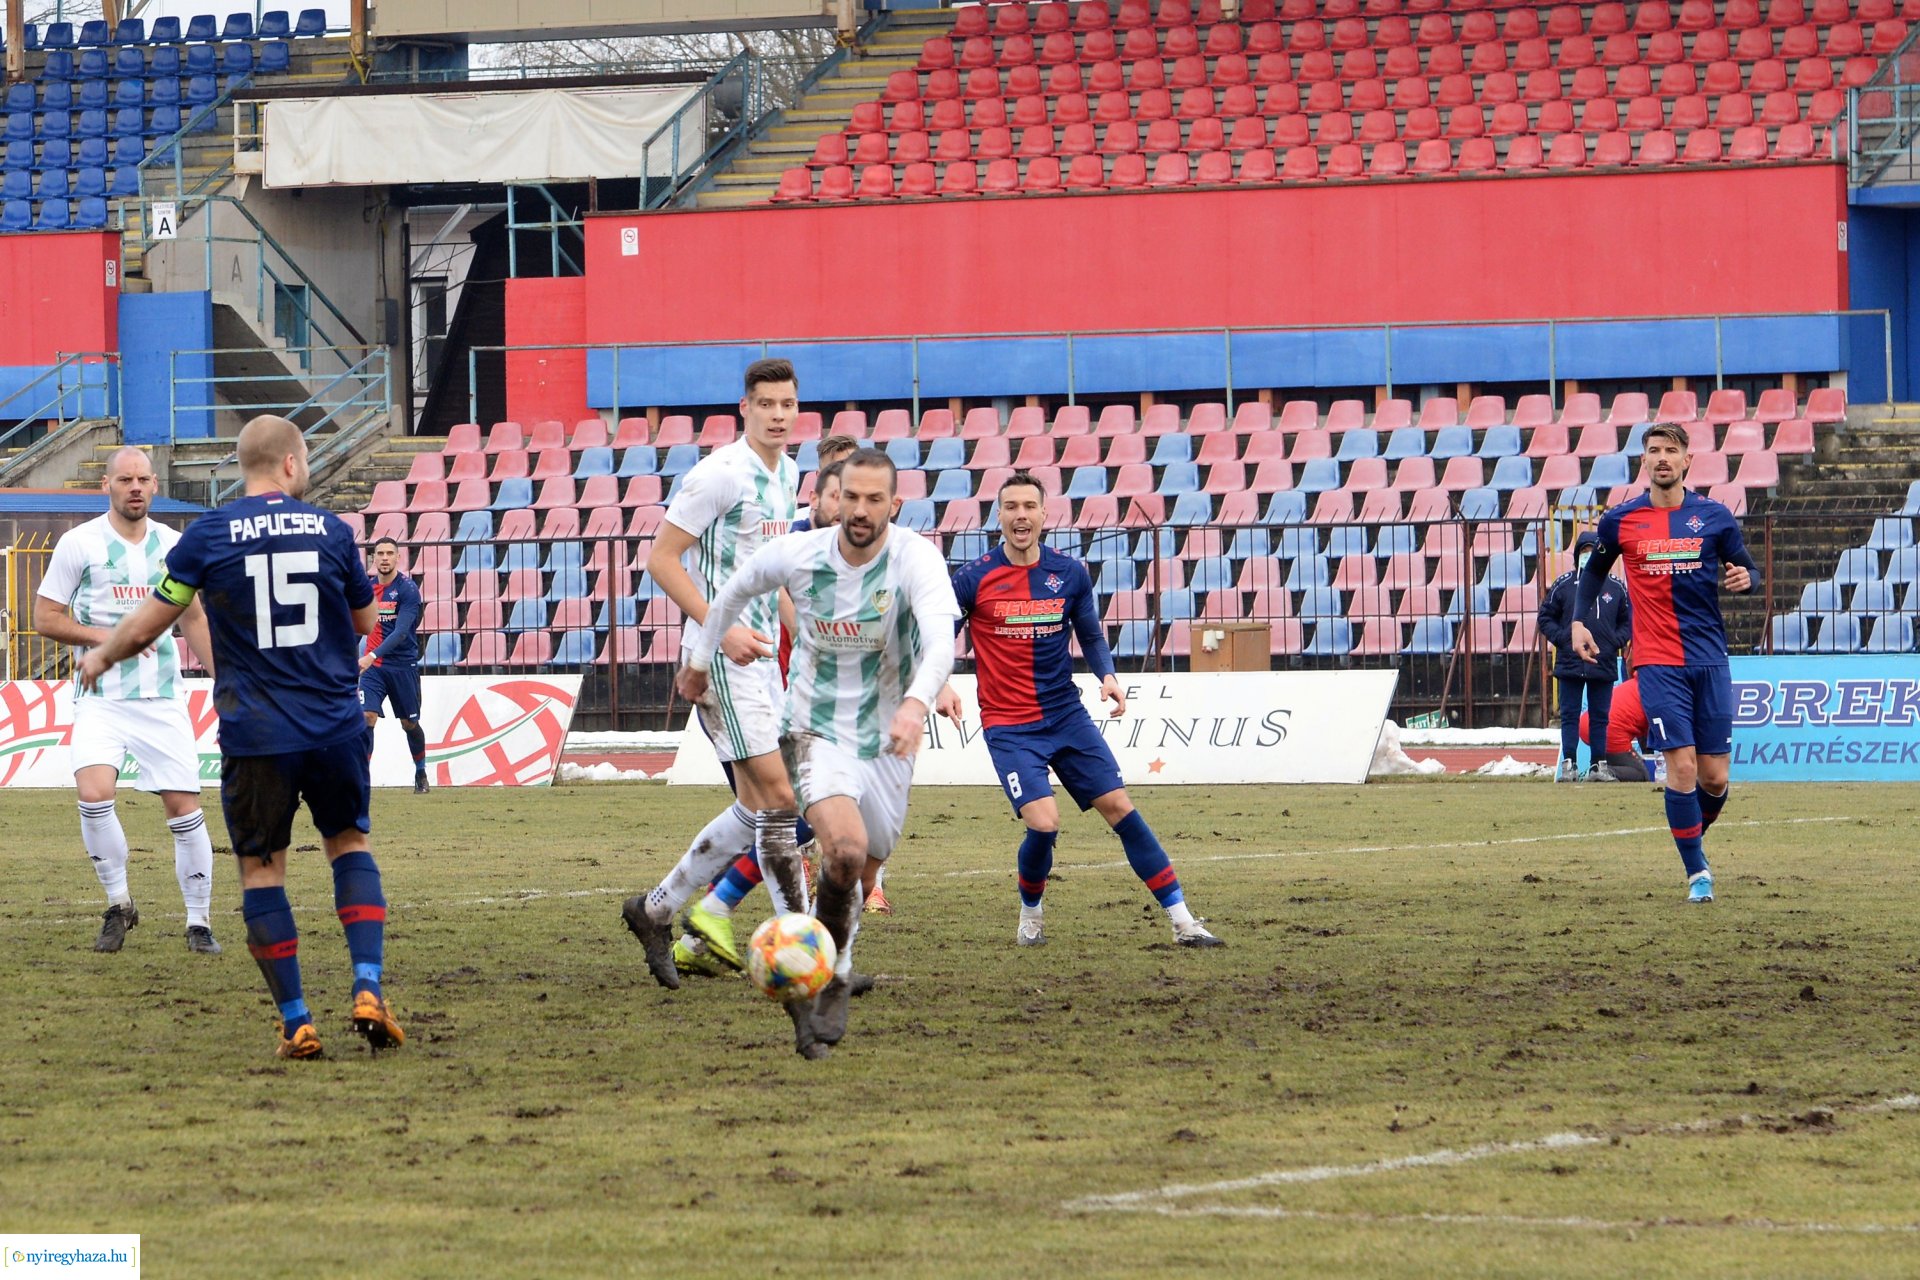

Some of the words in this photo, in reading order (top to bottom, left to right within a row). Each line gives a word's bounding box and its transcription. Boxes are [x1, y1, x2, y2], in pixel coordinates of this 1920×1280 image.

[159, 217, 171, 235] A
[231, 254, 243, 282] A
[229, 512, 328, 543] PAPUCSEK
[115, 598, 142, 606] autom
[244, 550, 320, 650] 15
[820, 633, 880, 644] automotive
[1732, 679, 1920, 729] BREK
[922, 708, 1293, 752] AVTINUS
[1653, 717, 1667, 741] 7
[1733, 735, 1920, 765] LKATRÉSZEK
[1007, 771, 1022, 799] 8
